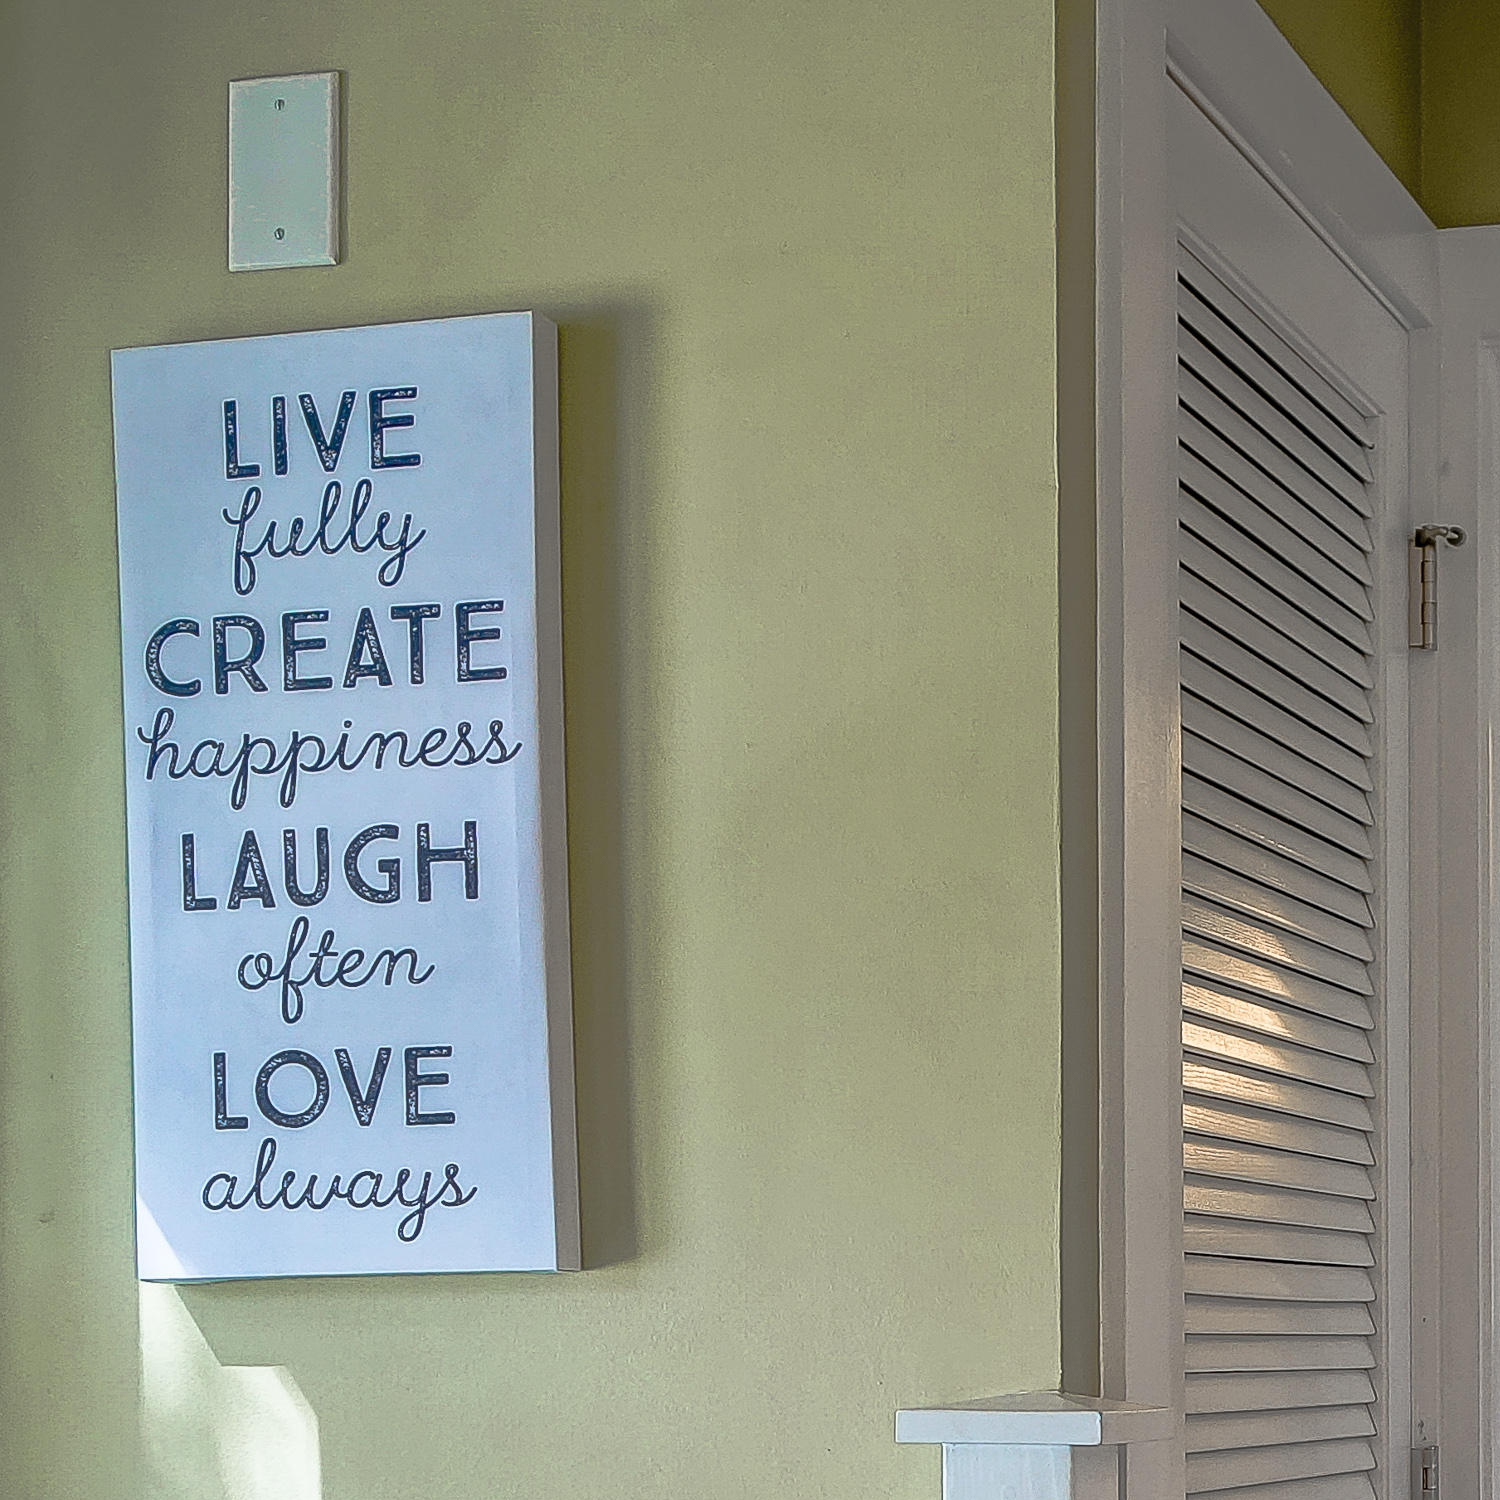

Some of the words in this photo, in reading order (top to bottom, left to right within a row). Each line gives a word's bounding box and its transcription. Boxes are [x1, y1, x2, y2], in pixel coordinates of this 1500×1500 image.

[223, 386, 423, 480] LIVE
[222, 478, 428, 596] fully
[145, 600, 509, 698] CREATE
[137, 706, 524, 811] happiness
[181, 820, 480, 912] LAUGH
[236, 915, 437, 1024] often
[213, 1045, 457, 1131] LOVE
[201, 1136, 479, 1243] always
